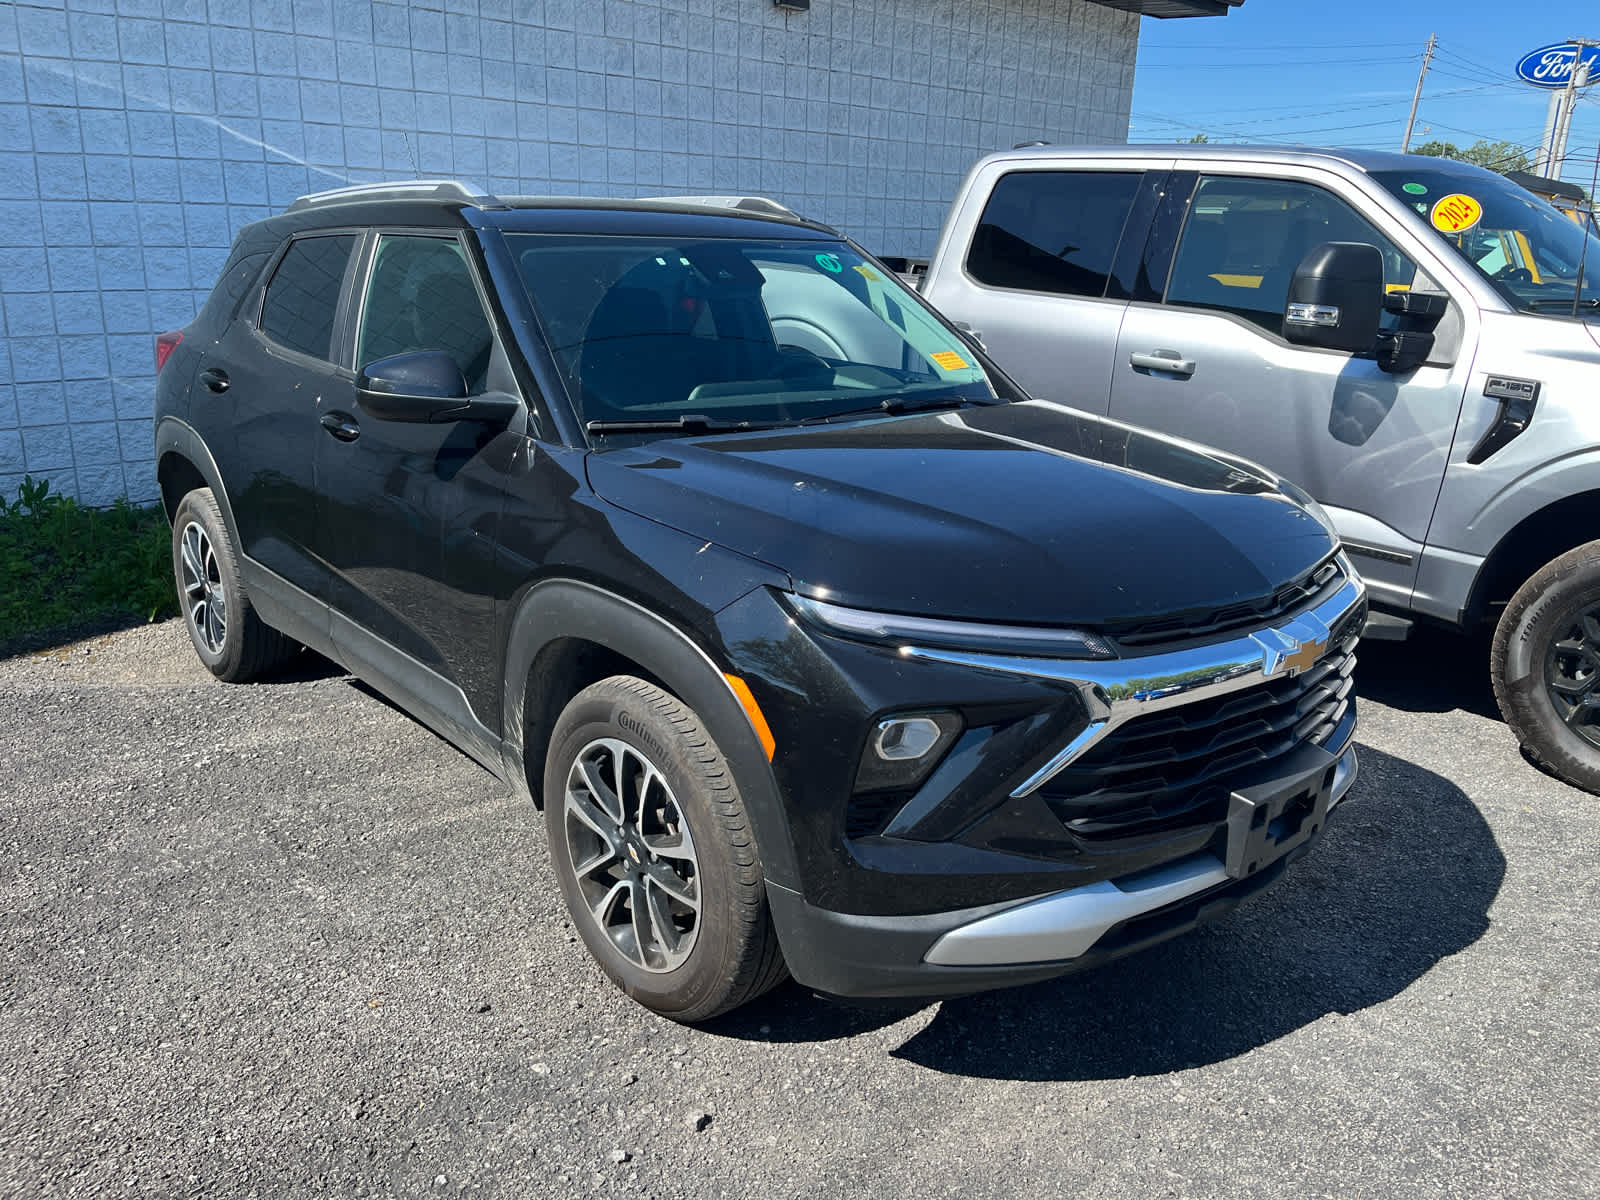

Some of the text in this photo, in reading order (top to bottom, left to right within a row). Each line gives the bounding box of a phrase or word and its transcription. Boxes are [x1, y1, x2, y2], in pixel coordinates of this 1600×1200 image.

[1533, 51, 1598, 78] Ford
[1438, 196, 1474, 229] 2024
[1489, 380, 1534, 393] F-150
[618, 710, 680, 775] Continental
